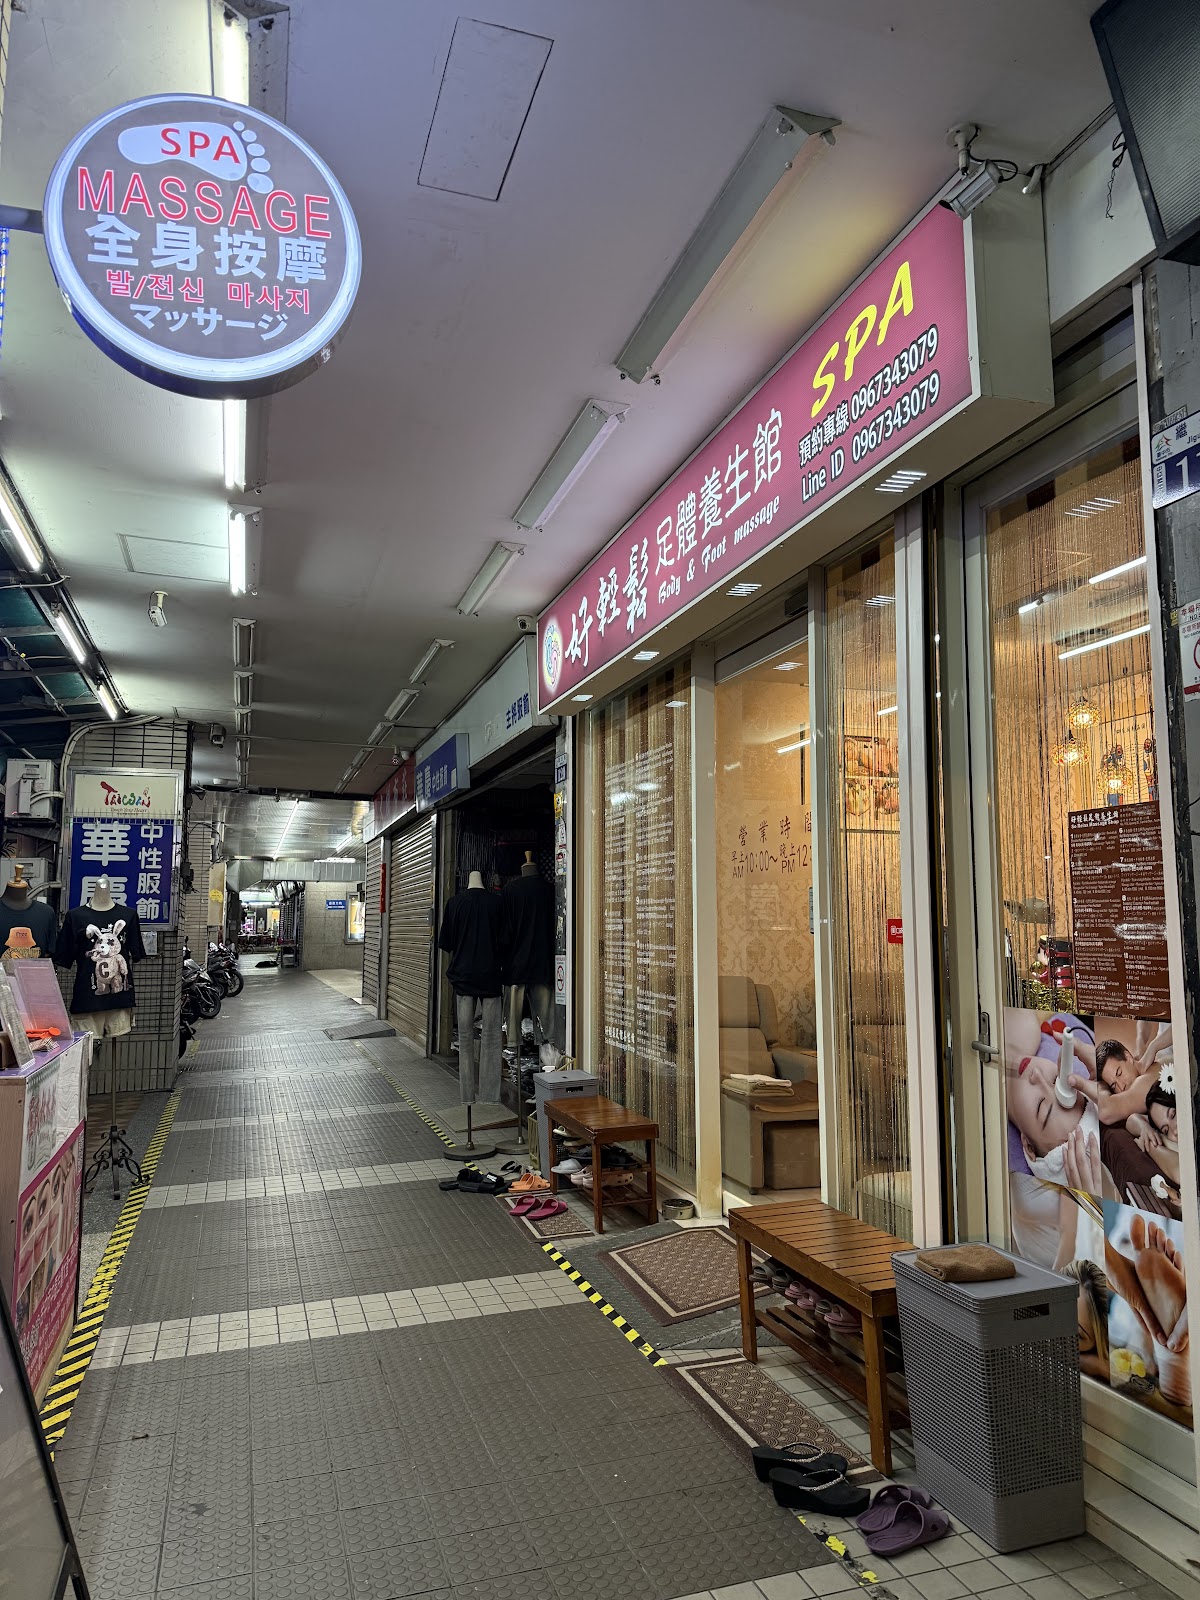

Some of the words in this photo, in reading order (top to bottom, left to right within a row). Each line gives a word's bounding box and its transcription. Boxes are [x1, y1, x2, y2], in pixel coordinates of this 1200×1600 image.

[160, 127, 241, 165] SPA
[77, 166, 332, 239] MASSAGE
[85, 213, 327, 285] 全身按摩
[106, 269, 205, 303] 발/전신
[227, 282, 311, 315] 마사지
[129, 303, 288, 340] マッサージ
[810, 260, 914, 418] SPA
[799, 403, 849, 466] 預約專線
[850, 325, 938, 421] 0967343079
[802, 466, 827, 503] Line
[830, 449, 845, 481] ID
[852, 371, 940, 463] 0967343079
[565, 407, 782, 667] 好輕鬆足體養生館
[658, 575, 681, 604] Body
[686, 558, 696, 583] &
[701, 535, 727, 573] Foot
[733, 495, 780, 545] massage
[136, 824, 163, 921] 中性服飾
[732, 865, 744, 879] AM
[781, 859, 796, 874] PM
